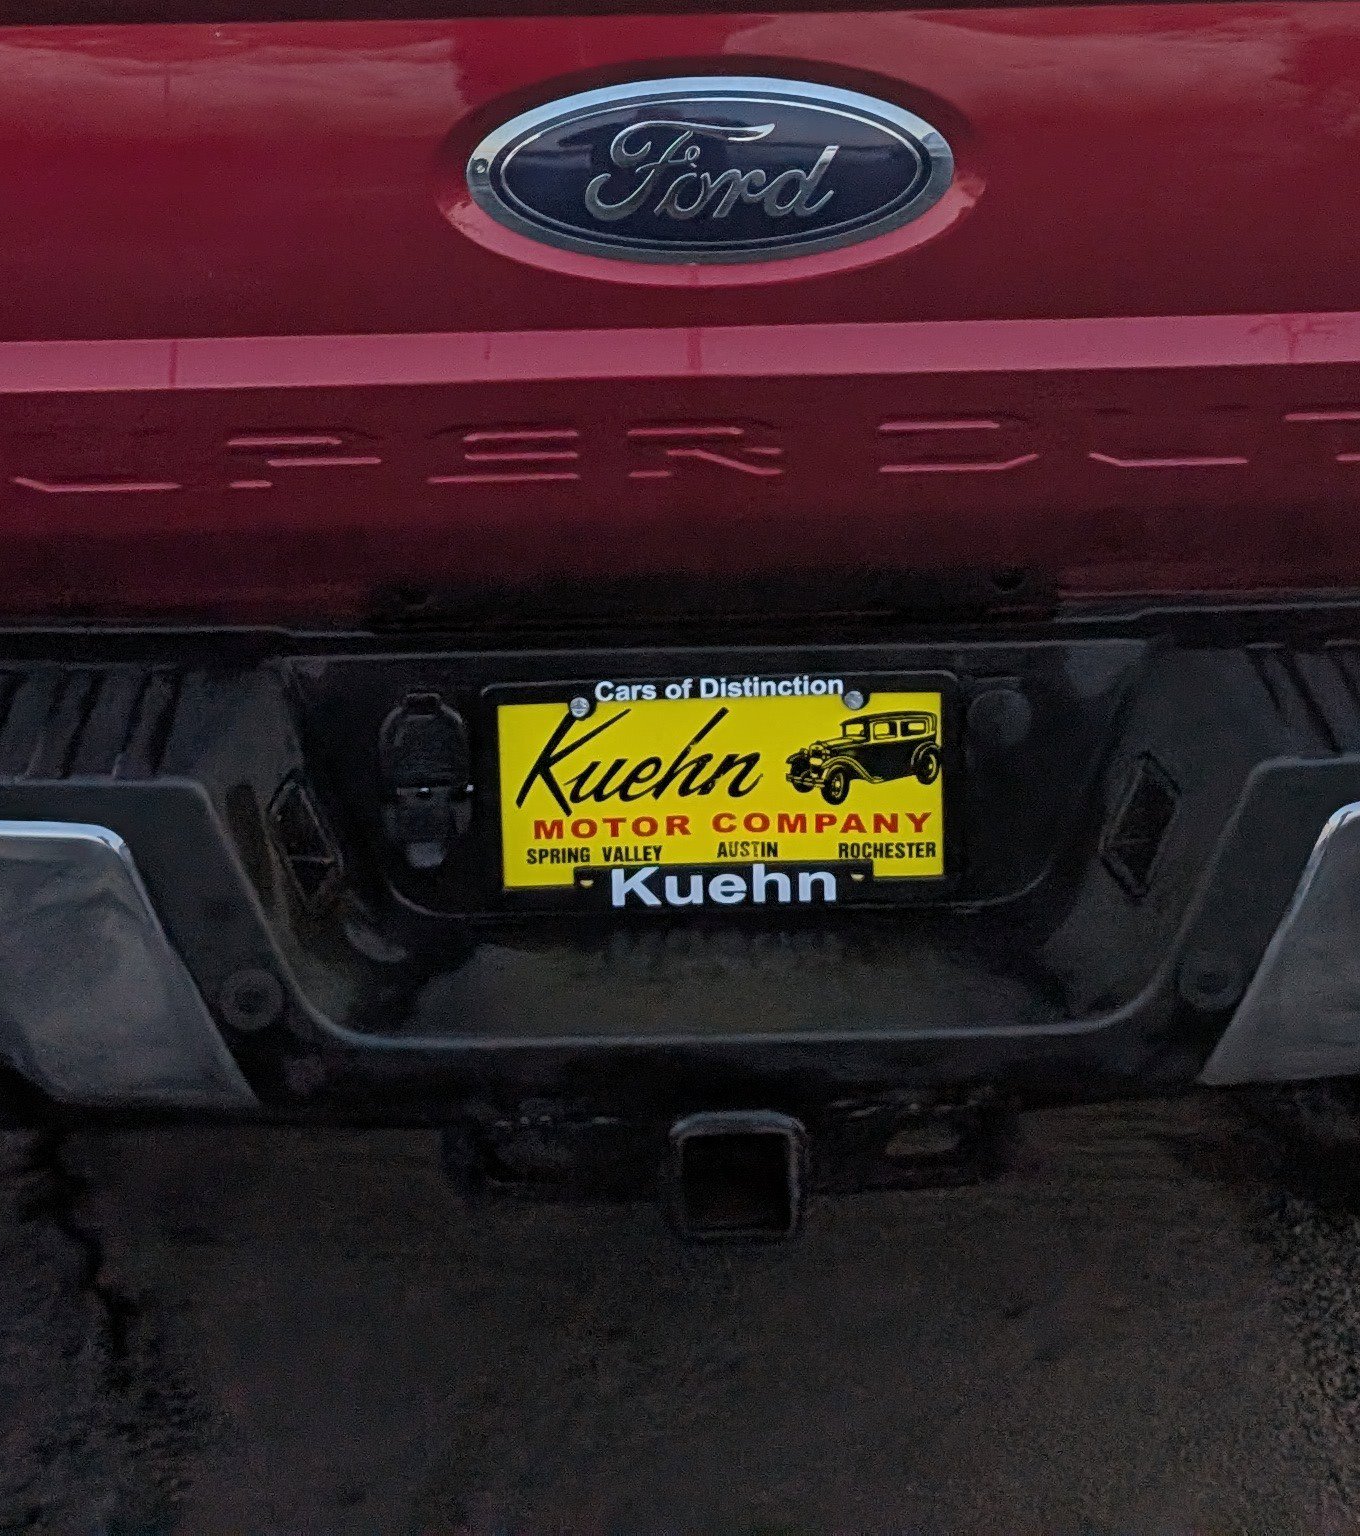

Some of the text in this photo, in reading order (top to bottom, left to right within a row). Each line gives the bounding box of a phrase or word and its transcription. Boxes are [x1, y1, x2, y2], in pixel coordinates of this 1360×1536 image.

[584, 120, 841, 221] Ford
[594, 675, 844, 702] Cars of Distinction
[516, 707, 763, 816] Kuehn
[533, 811, 931, 840] MOTOR COMPANY
[526, 841, 936, 864] SPRING VALLEY AUSTIN ROCHESTER
[611, 864, 837, 907] Kuehn
